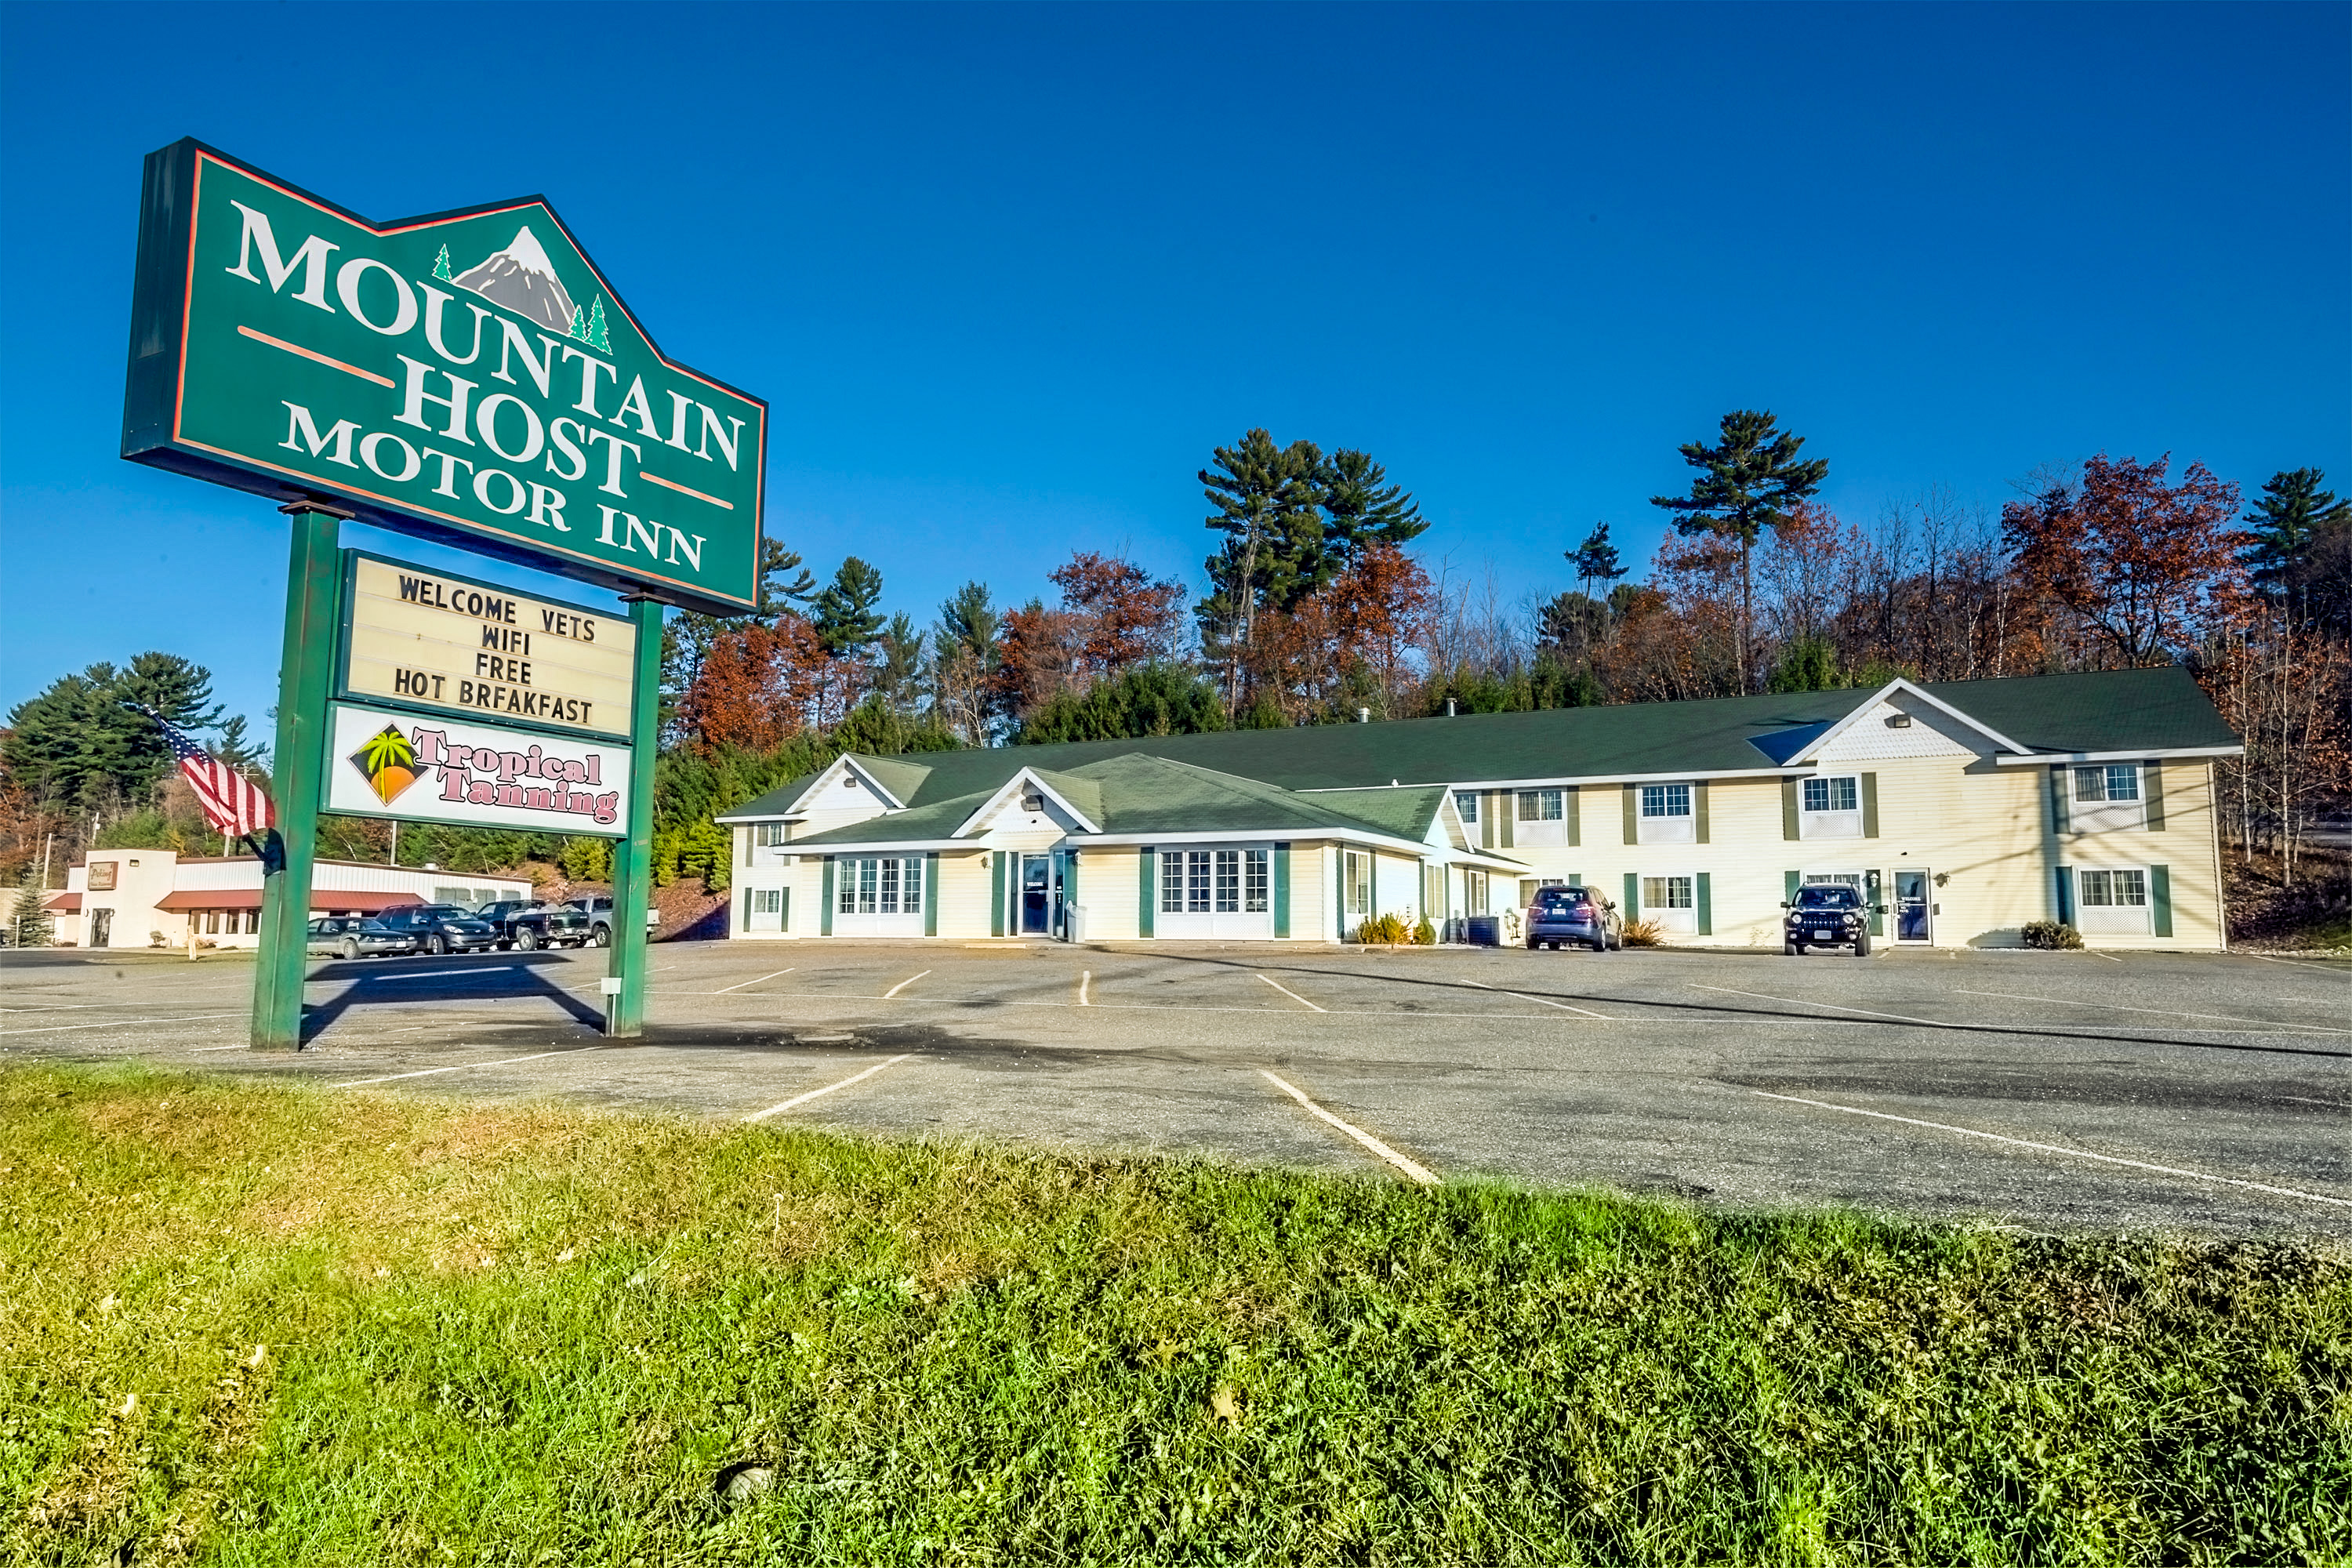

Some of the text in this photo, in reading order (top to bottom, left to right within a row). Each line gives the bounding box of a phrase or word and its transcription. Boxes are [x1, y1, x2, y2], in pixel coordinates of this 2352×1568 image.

[225, 199, 746, 472] MOUNTAIN
[392, 353, 641, 499] HOST
[278, 400, 707, 572] MOTOR INN
[399, 575, 595, 641] WELCOME VETS
[475, 652, 531, 684] FREE
[482, 624, 530, 655] WIFI
[395, 668, 592, 724] HOT BRFAKFAST
[412, 727, 601, 786] Tropical
[437, 764, 619, 824] Tanning
